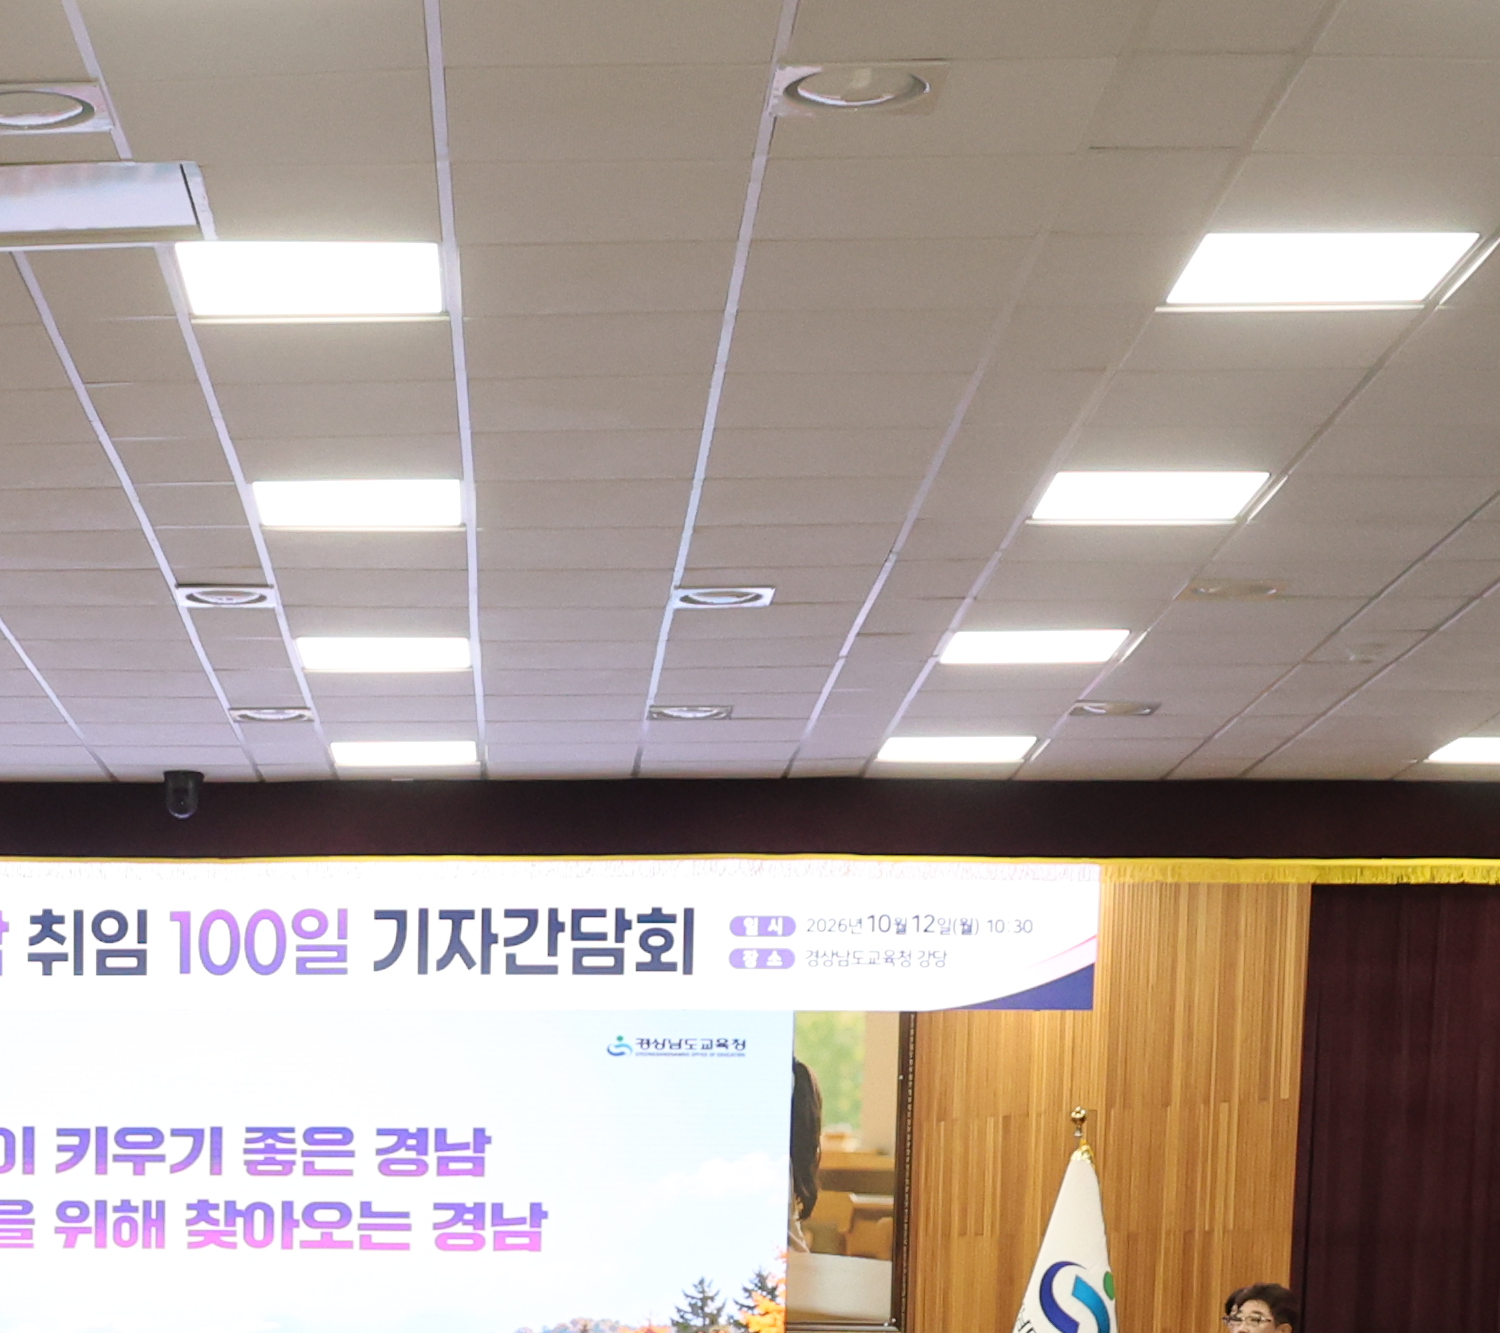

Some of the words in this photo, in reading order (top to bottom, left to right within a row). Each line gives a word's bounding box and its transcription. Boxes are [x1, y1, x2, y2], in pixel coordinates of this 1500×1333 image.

[27, 908, 148, 976] 취임
[169, 908, 348, 976] 100일
[373, 907, 695, 975] 기자간담회
[806, 917, 863, 934] 2026년
[986, 919, 1033, 934] 10:30
[805, 949, 912, 968] 경상남도교육청
[917, 950, 947, 968] 강당
[635, 1038, 746, 1051] 경상남도교육청
[55, 1126, 223, 1176] 키우기
[243, 1126, 355, 1177] 좋은
[375, 1127, 492, 1177] 경남
[54, 1199, 165, 1249] 위해
[185, 1199, 412, 1251] 찾아오는
[432, 1202, 549, 1252] 경남
